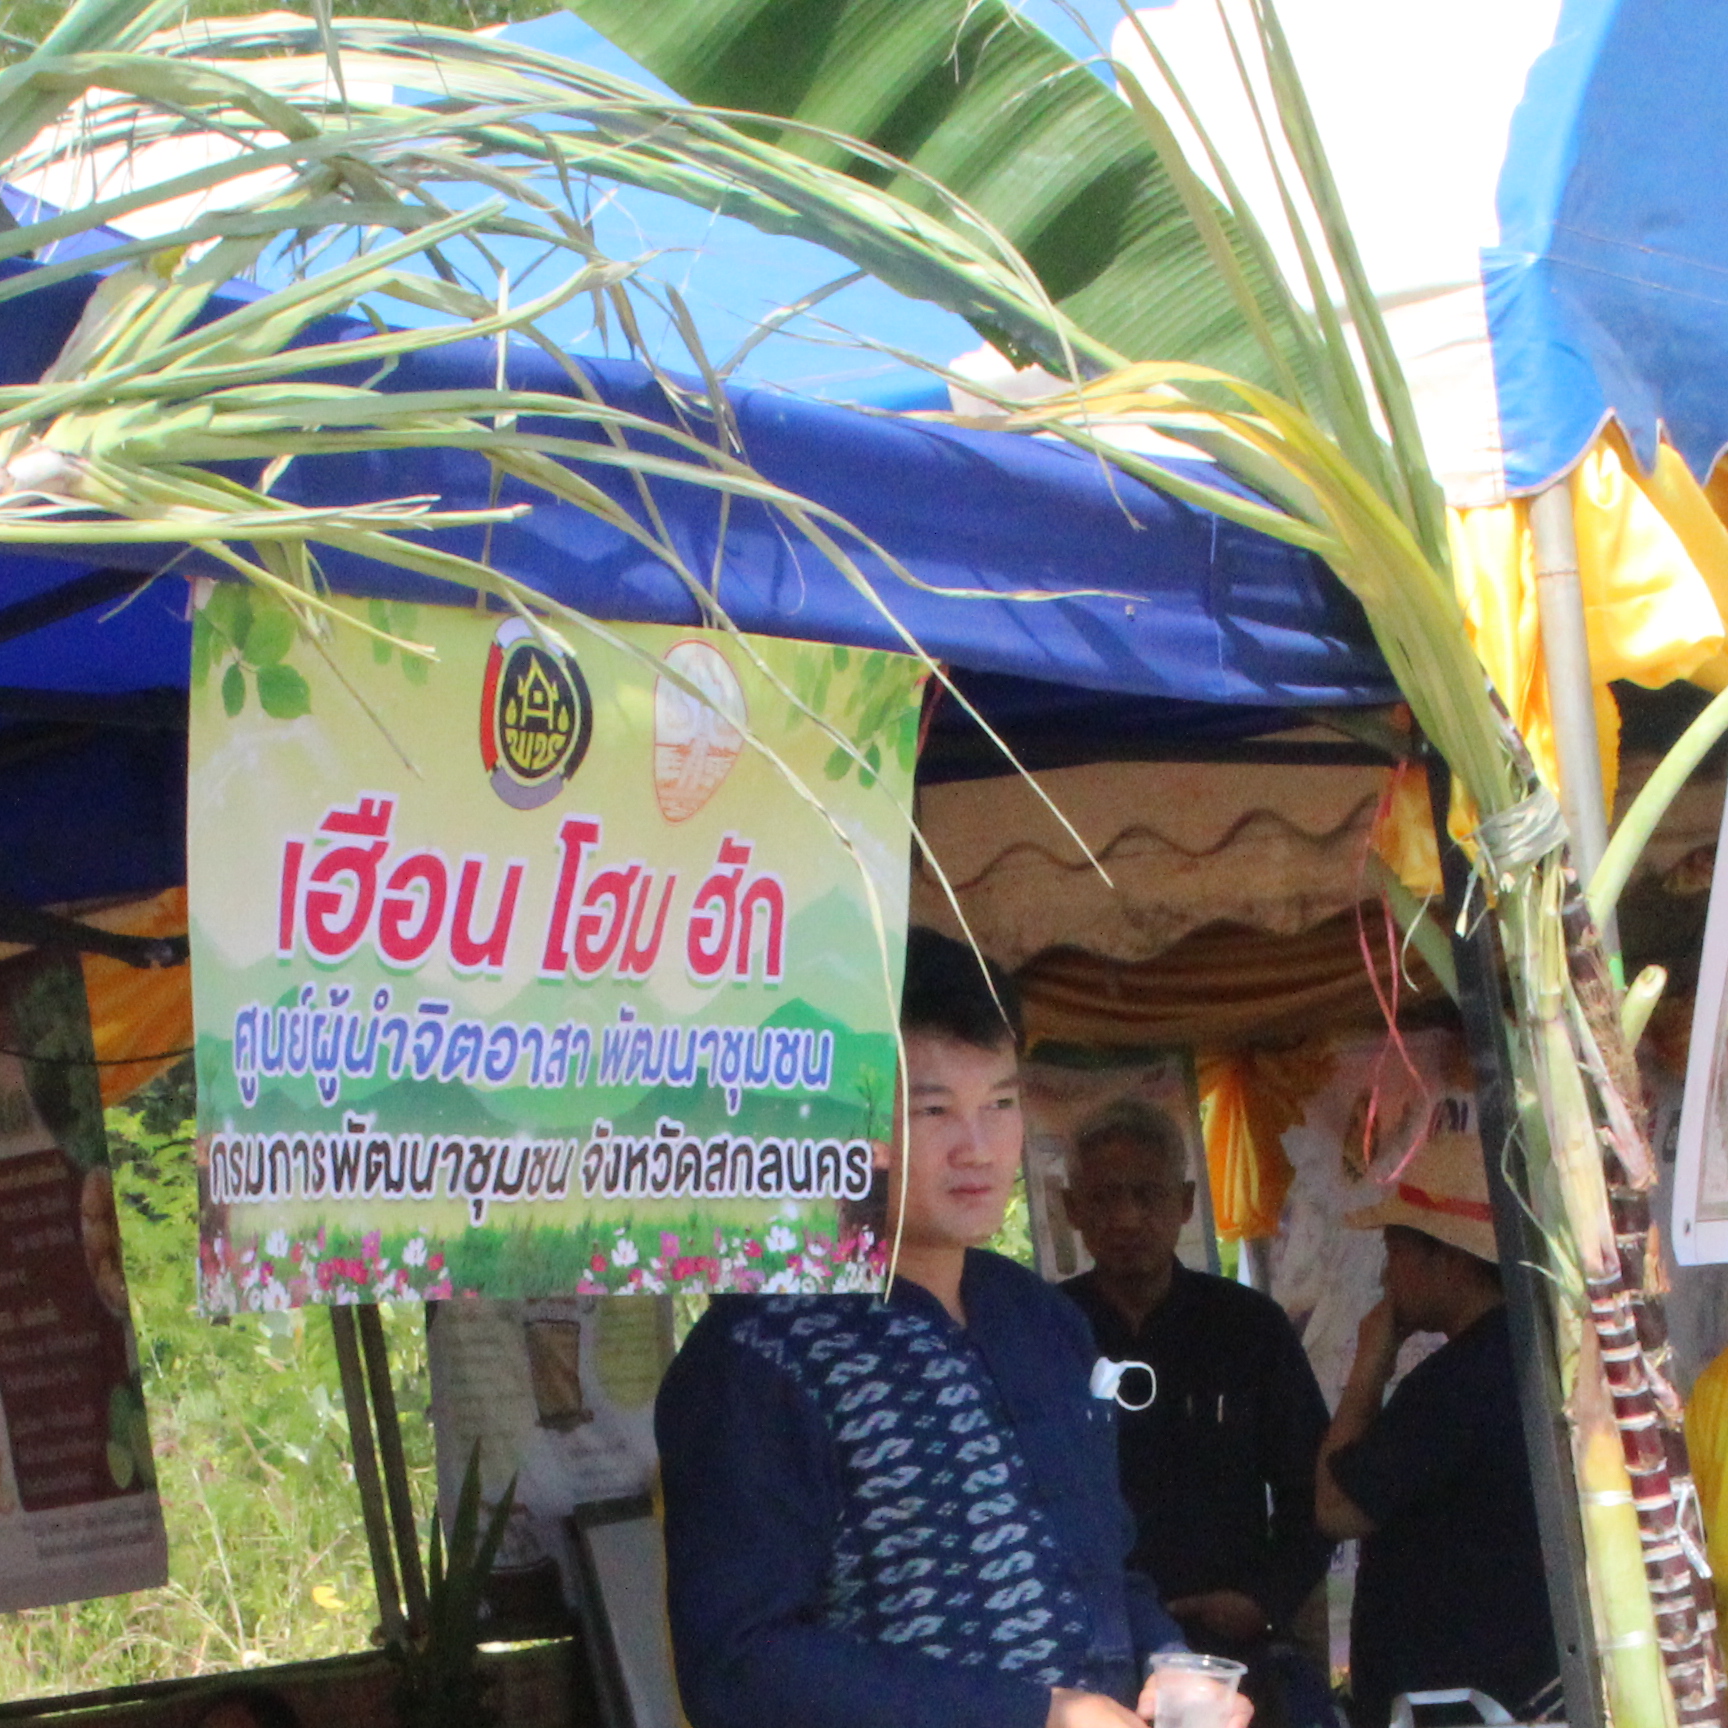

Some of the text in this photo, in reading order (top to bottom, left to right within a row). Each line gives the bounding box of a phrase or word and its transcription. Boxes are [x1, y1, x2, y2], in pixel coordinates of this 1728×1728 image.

[276, 798, 787, 982] เฮือน โฮม ฮัก
[233, 983, 833, 1114] ศูนย์ผู้นำจิตอาสา พัฒนาชุมชน
[209, 1115, 872, 1225] กรมการพัฒนาชุมชน จังหวัดสกลนคร
